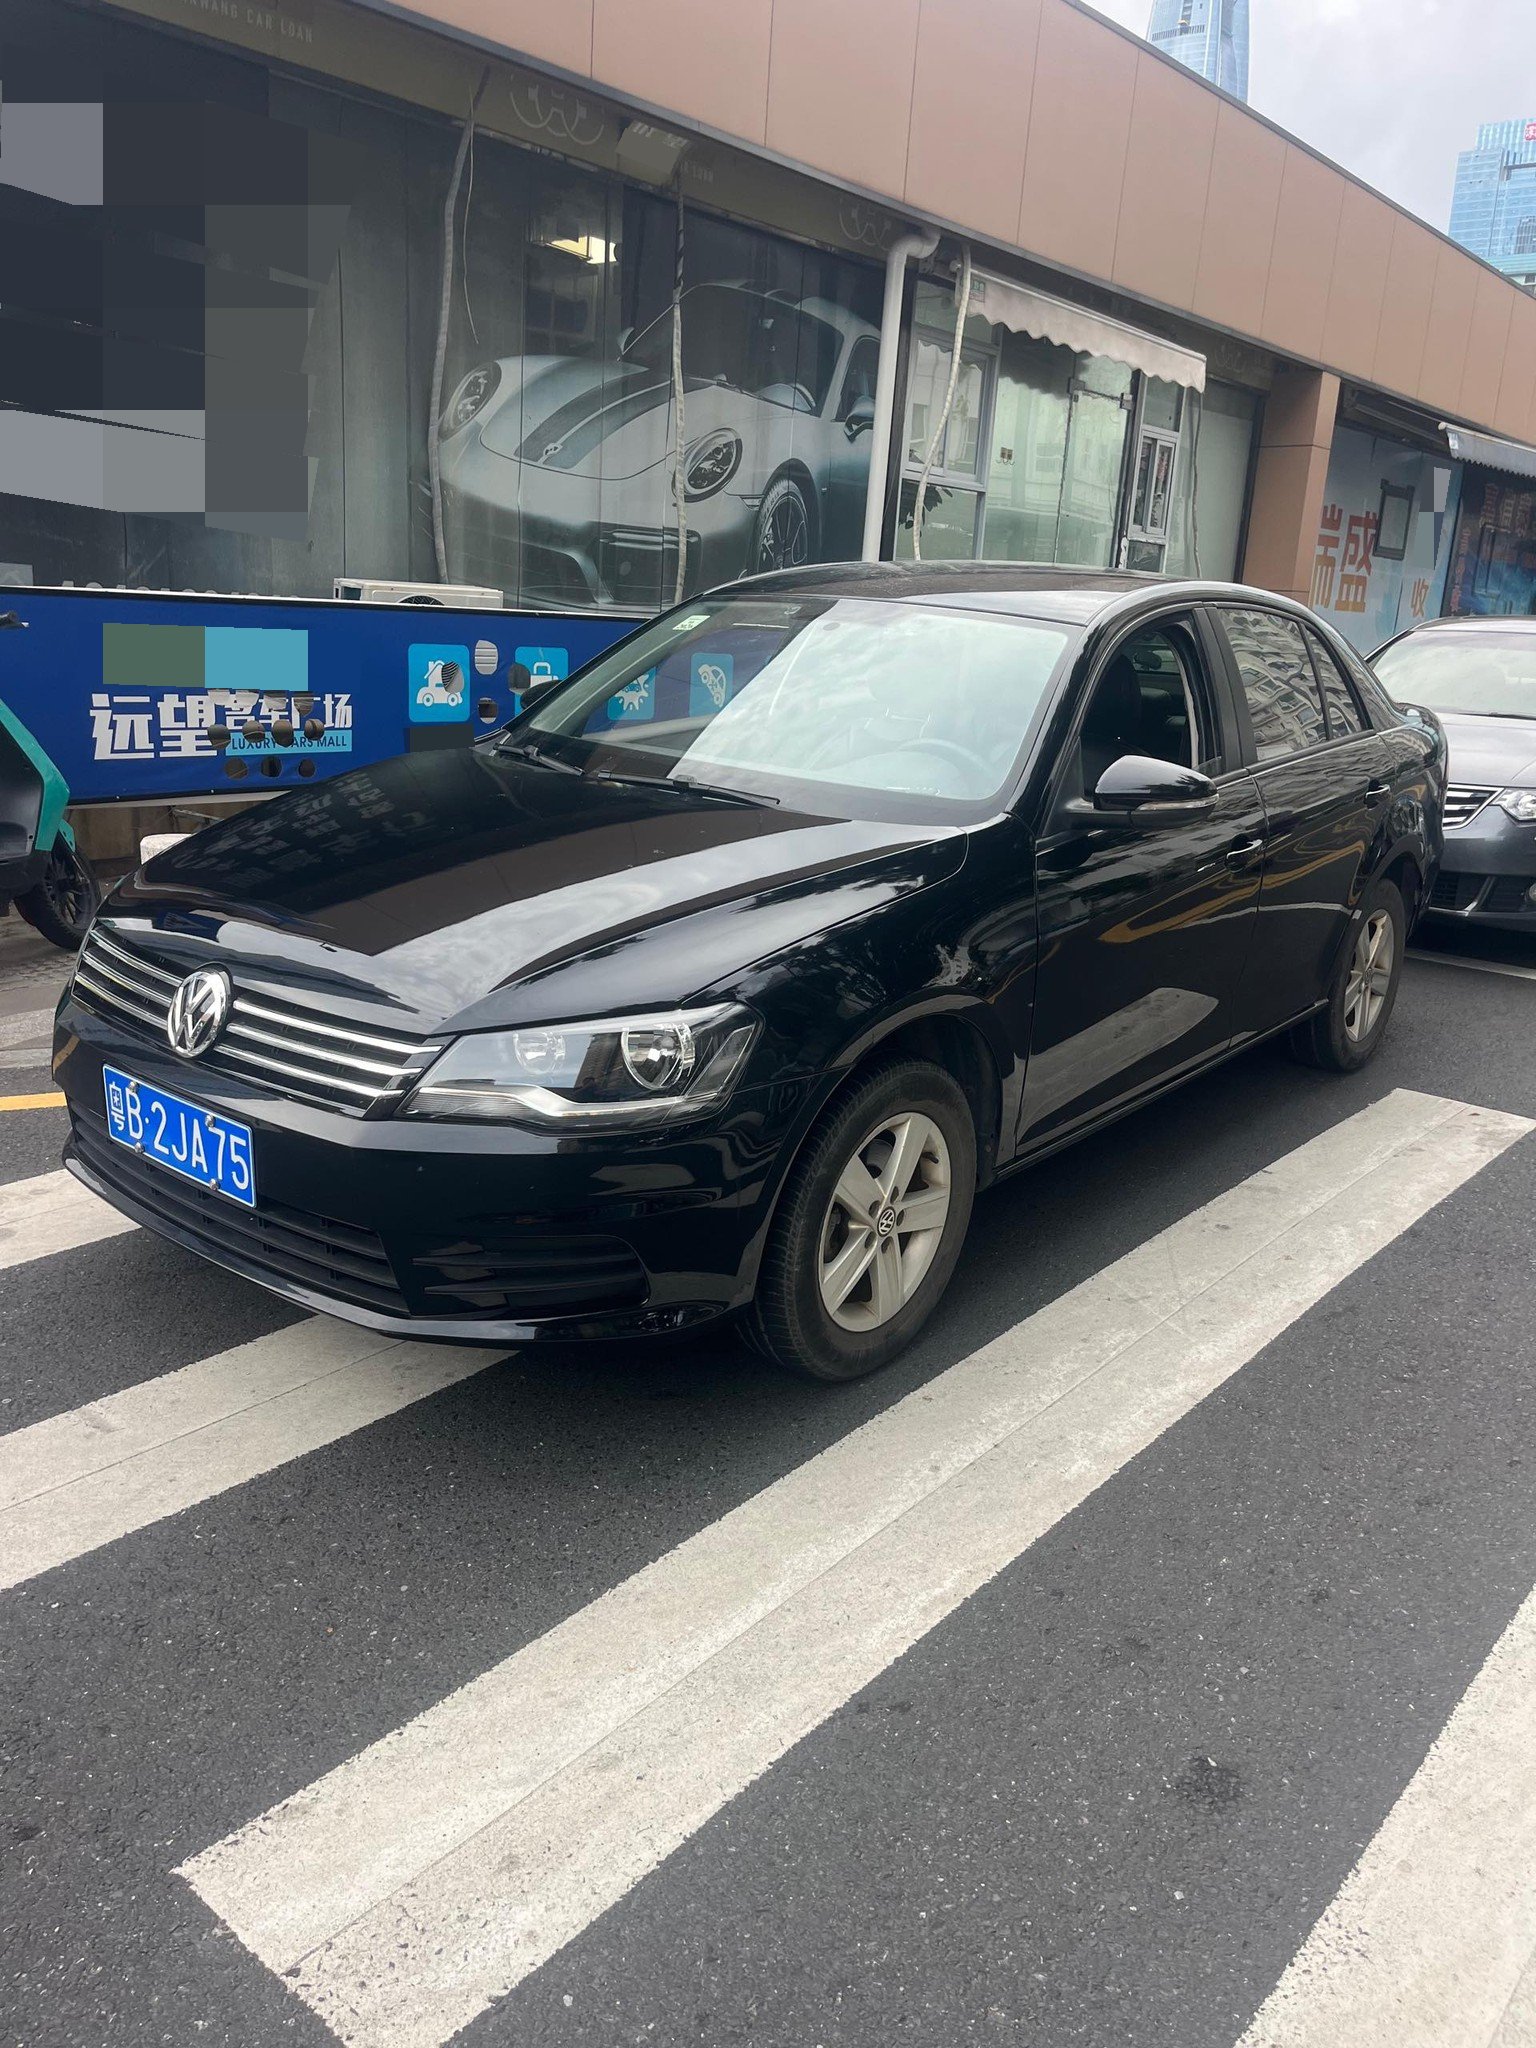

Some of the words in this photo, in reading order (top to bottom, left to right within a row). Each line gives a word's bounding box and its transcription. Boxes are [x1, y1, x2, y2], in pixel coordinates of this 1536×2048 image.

[247, 8, 273, 30] CAR
[280, 18, 313, 43] LOAN
[1410, 577, 1429, 618] 收
[286, 737, 314, 749] ARS
[317, 736, 347, 748] MALL
